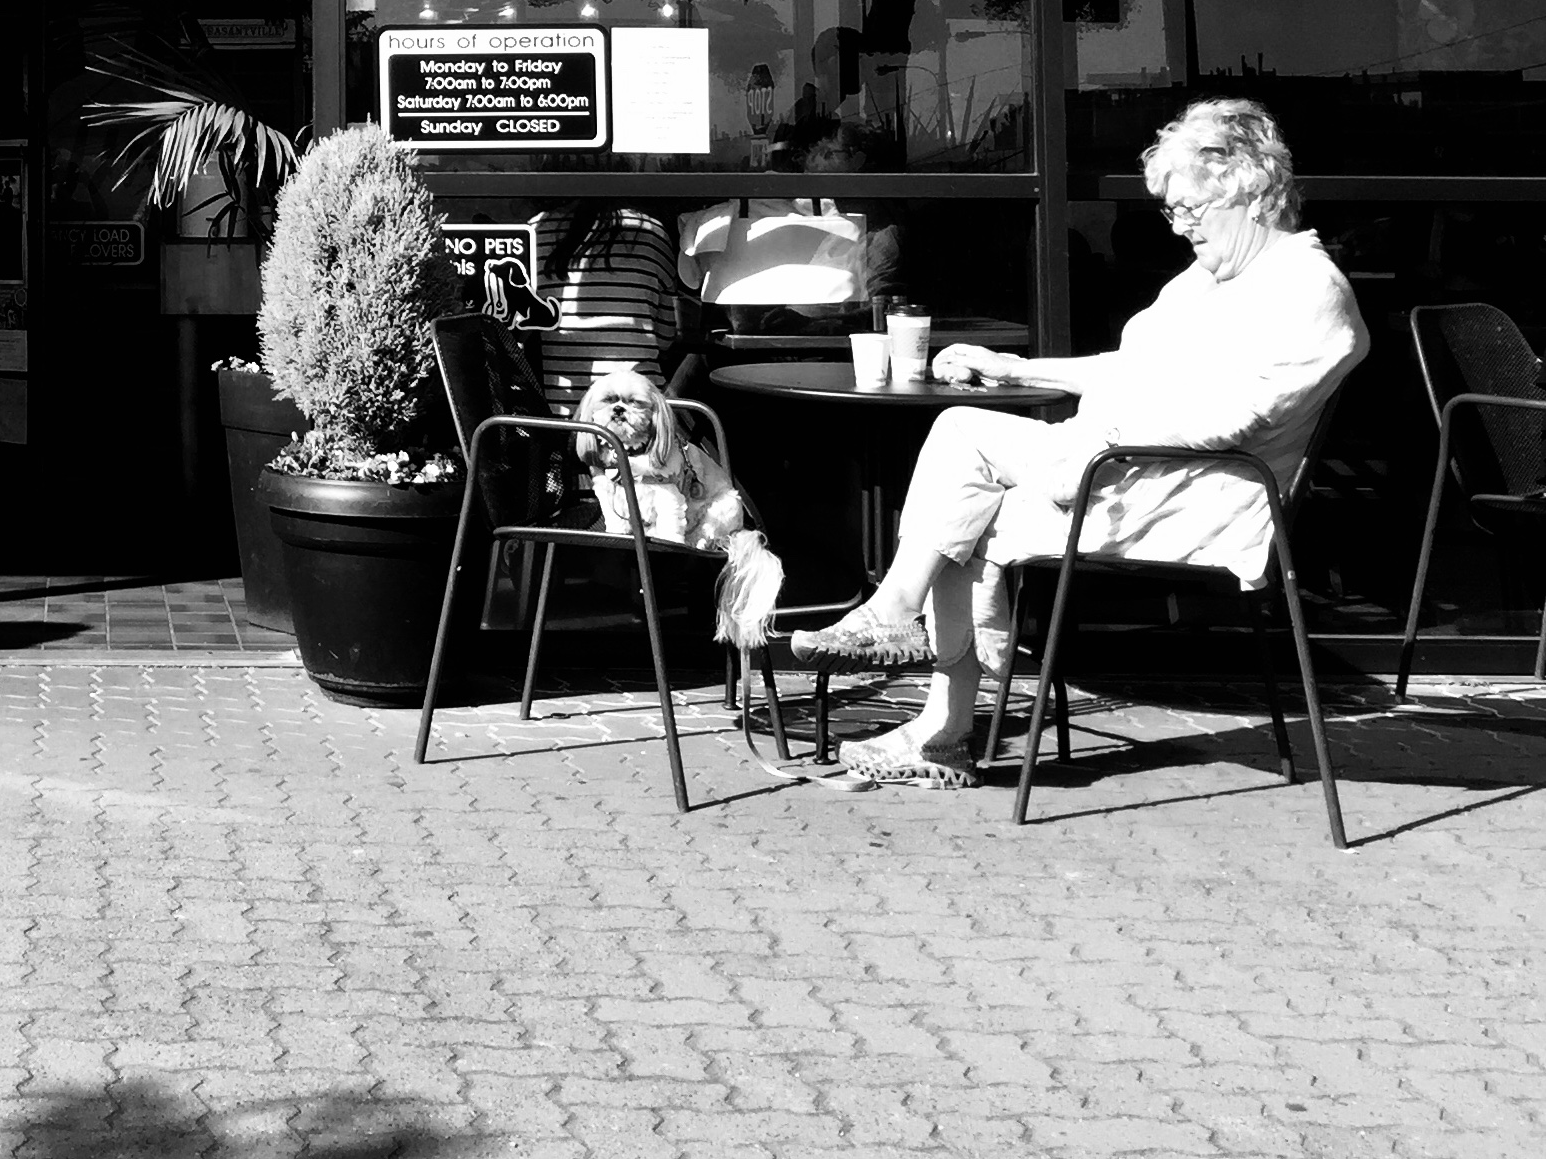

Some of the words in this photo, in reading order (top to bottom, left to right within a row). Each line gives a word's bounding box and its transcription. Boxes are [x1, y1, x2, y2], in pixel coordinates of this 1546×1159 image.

[389, 35, 445, 49] hours
[457, 34, 477, 48] of
[489, 34, 594, 51] operation
[420, 60, 486, 75] Monday
[492, 60, 508, 72] to
[515, 59, 562, 74] Friday
[424, 77, 476, 89] 7:00am
[481, 77, 494, 89] to
[499, 76, 551, 91] 7:00pm
[397, 95, 461, 110] Saturday
[465, 94, 515, 108] 7:00am
[520, 94, 533, 107] to
[537, 93, 589, 109] 6:00pm
[420, 120, 483, 135] Sunday
[496, 119, 560, 133] CLOSED
[84, 244, 135, 257] OVERS
[444, 238, 477, 254] NO
[484, 238, 525, 254] PETS
